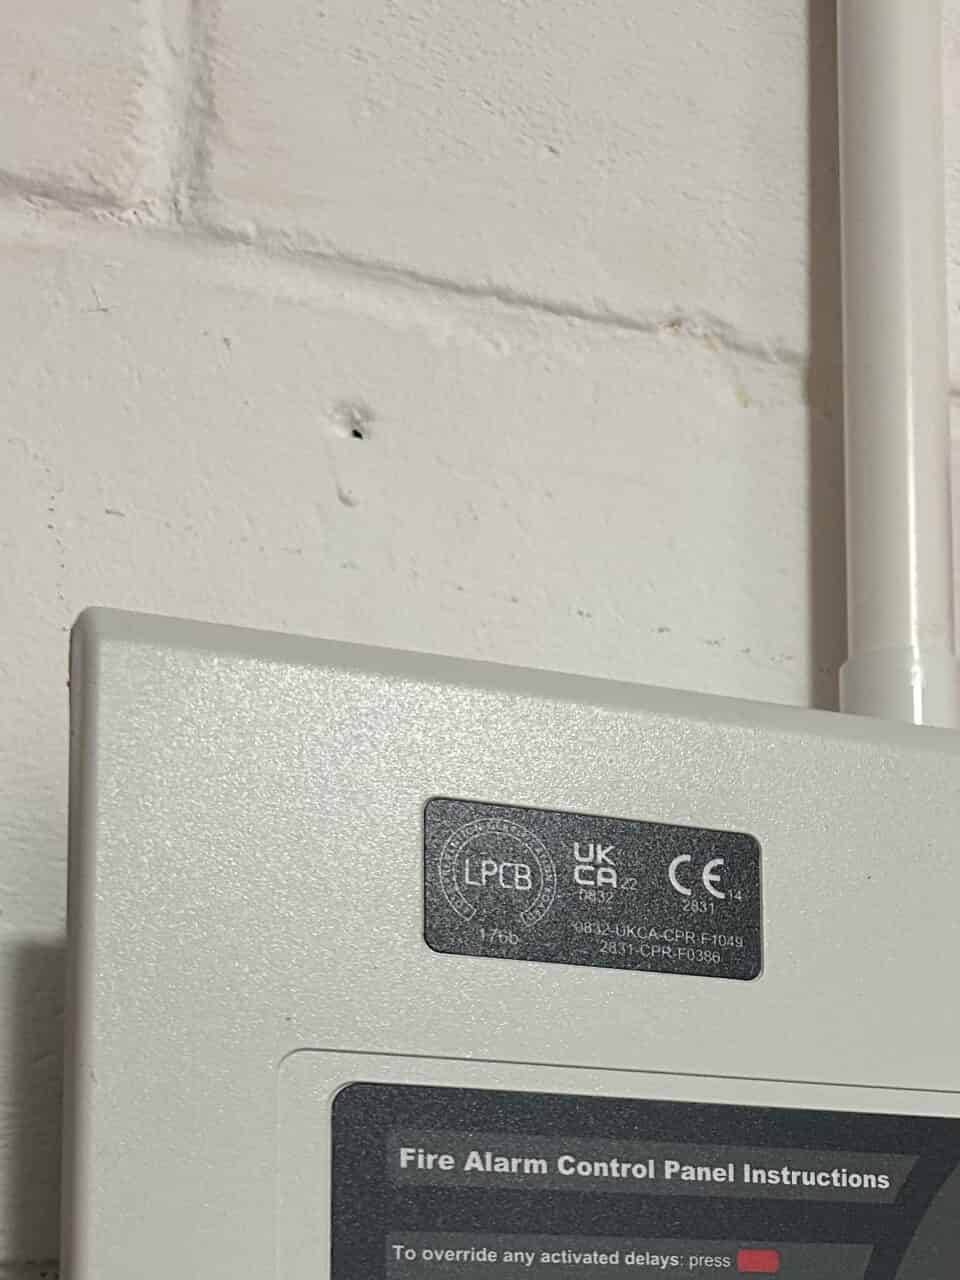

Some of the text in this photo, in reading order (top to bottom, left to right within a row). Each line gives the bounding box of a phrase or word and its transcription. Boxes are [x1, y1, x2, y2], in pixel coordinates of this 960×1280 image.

[574, 842, 616, 866] UK
[465, 859, 532, 890] LPCB
[574, 865, 617, 888] CA
[669, 854, 725, 899] CE
[400, 1148, 890, 1190] Fire Alarm Control Panel Instructions
[393, 1245, 731, 1269] To override any activated delays: press
